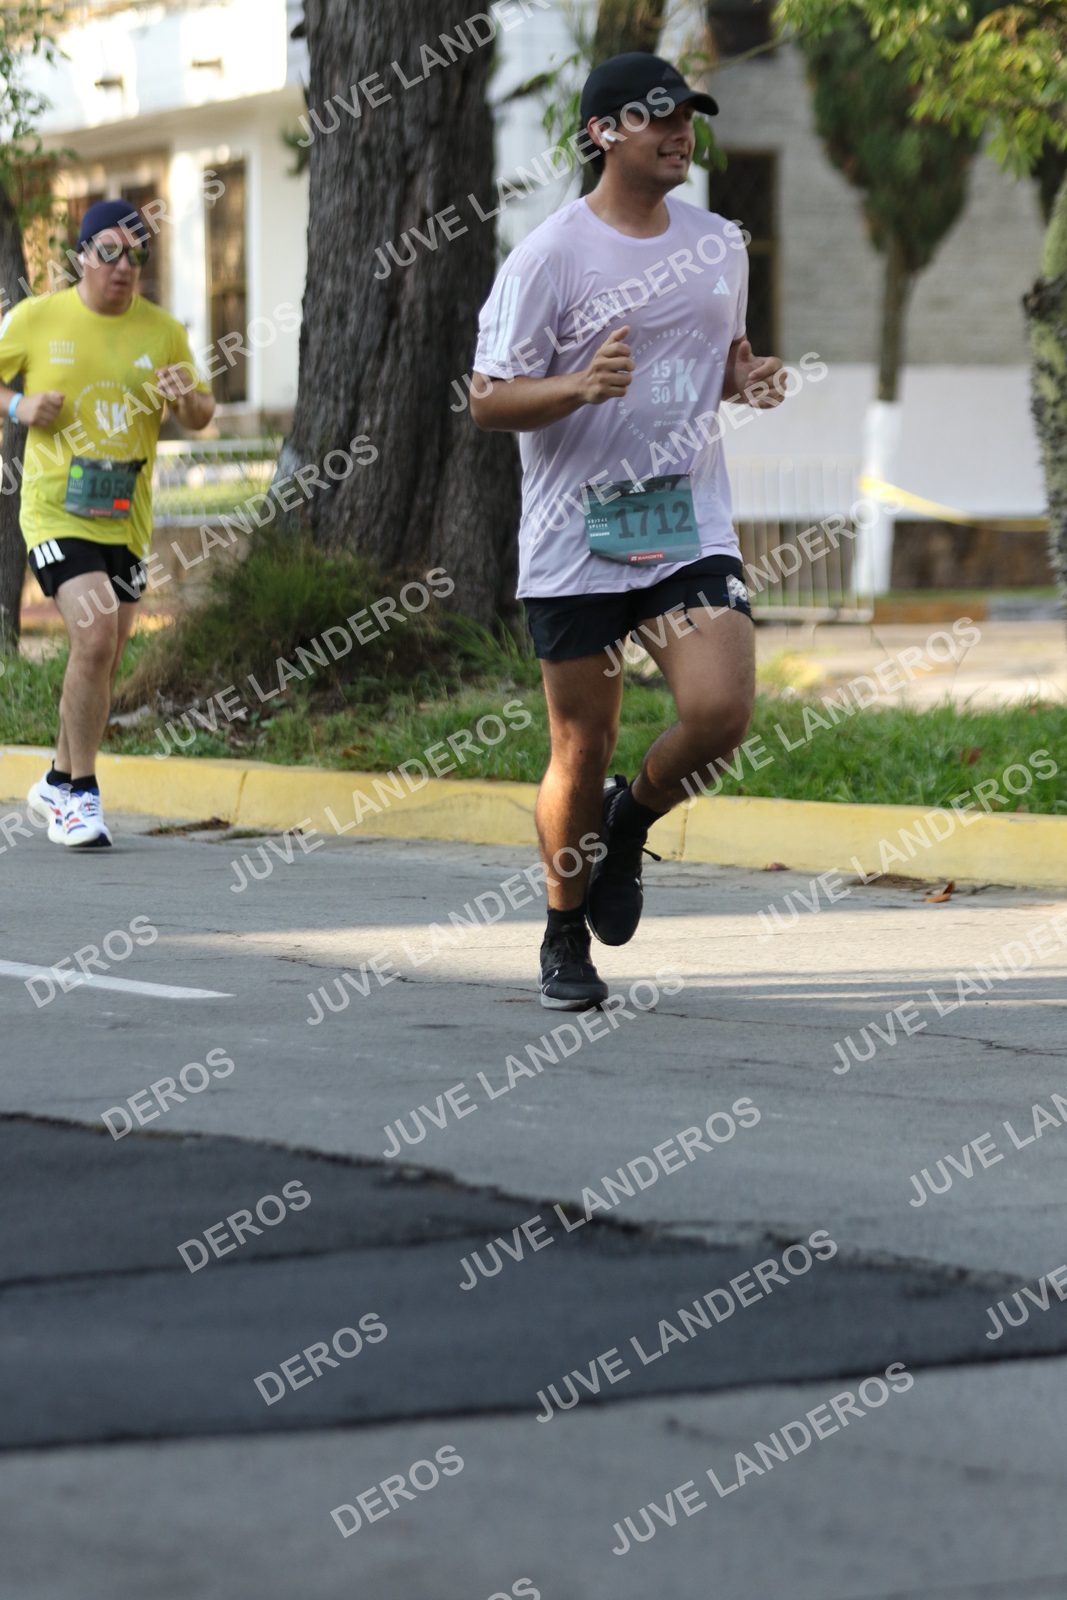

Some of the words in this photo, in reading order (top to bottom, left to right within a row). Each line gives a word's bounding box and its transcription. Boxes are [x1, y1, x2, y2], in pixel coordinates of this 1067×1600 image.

[651, 360, 671, 378] 15
[674, 358, 698, 402] K
[651, 386, 671, 404] 30
[615, 501, 693, 539] 1712
